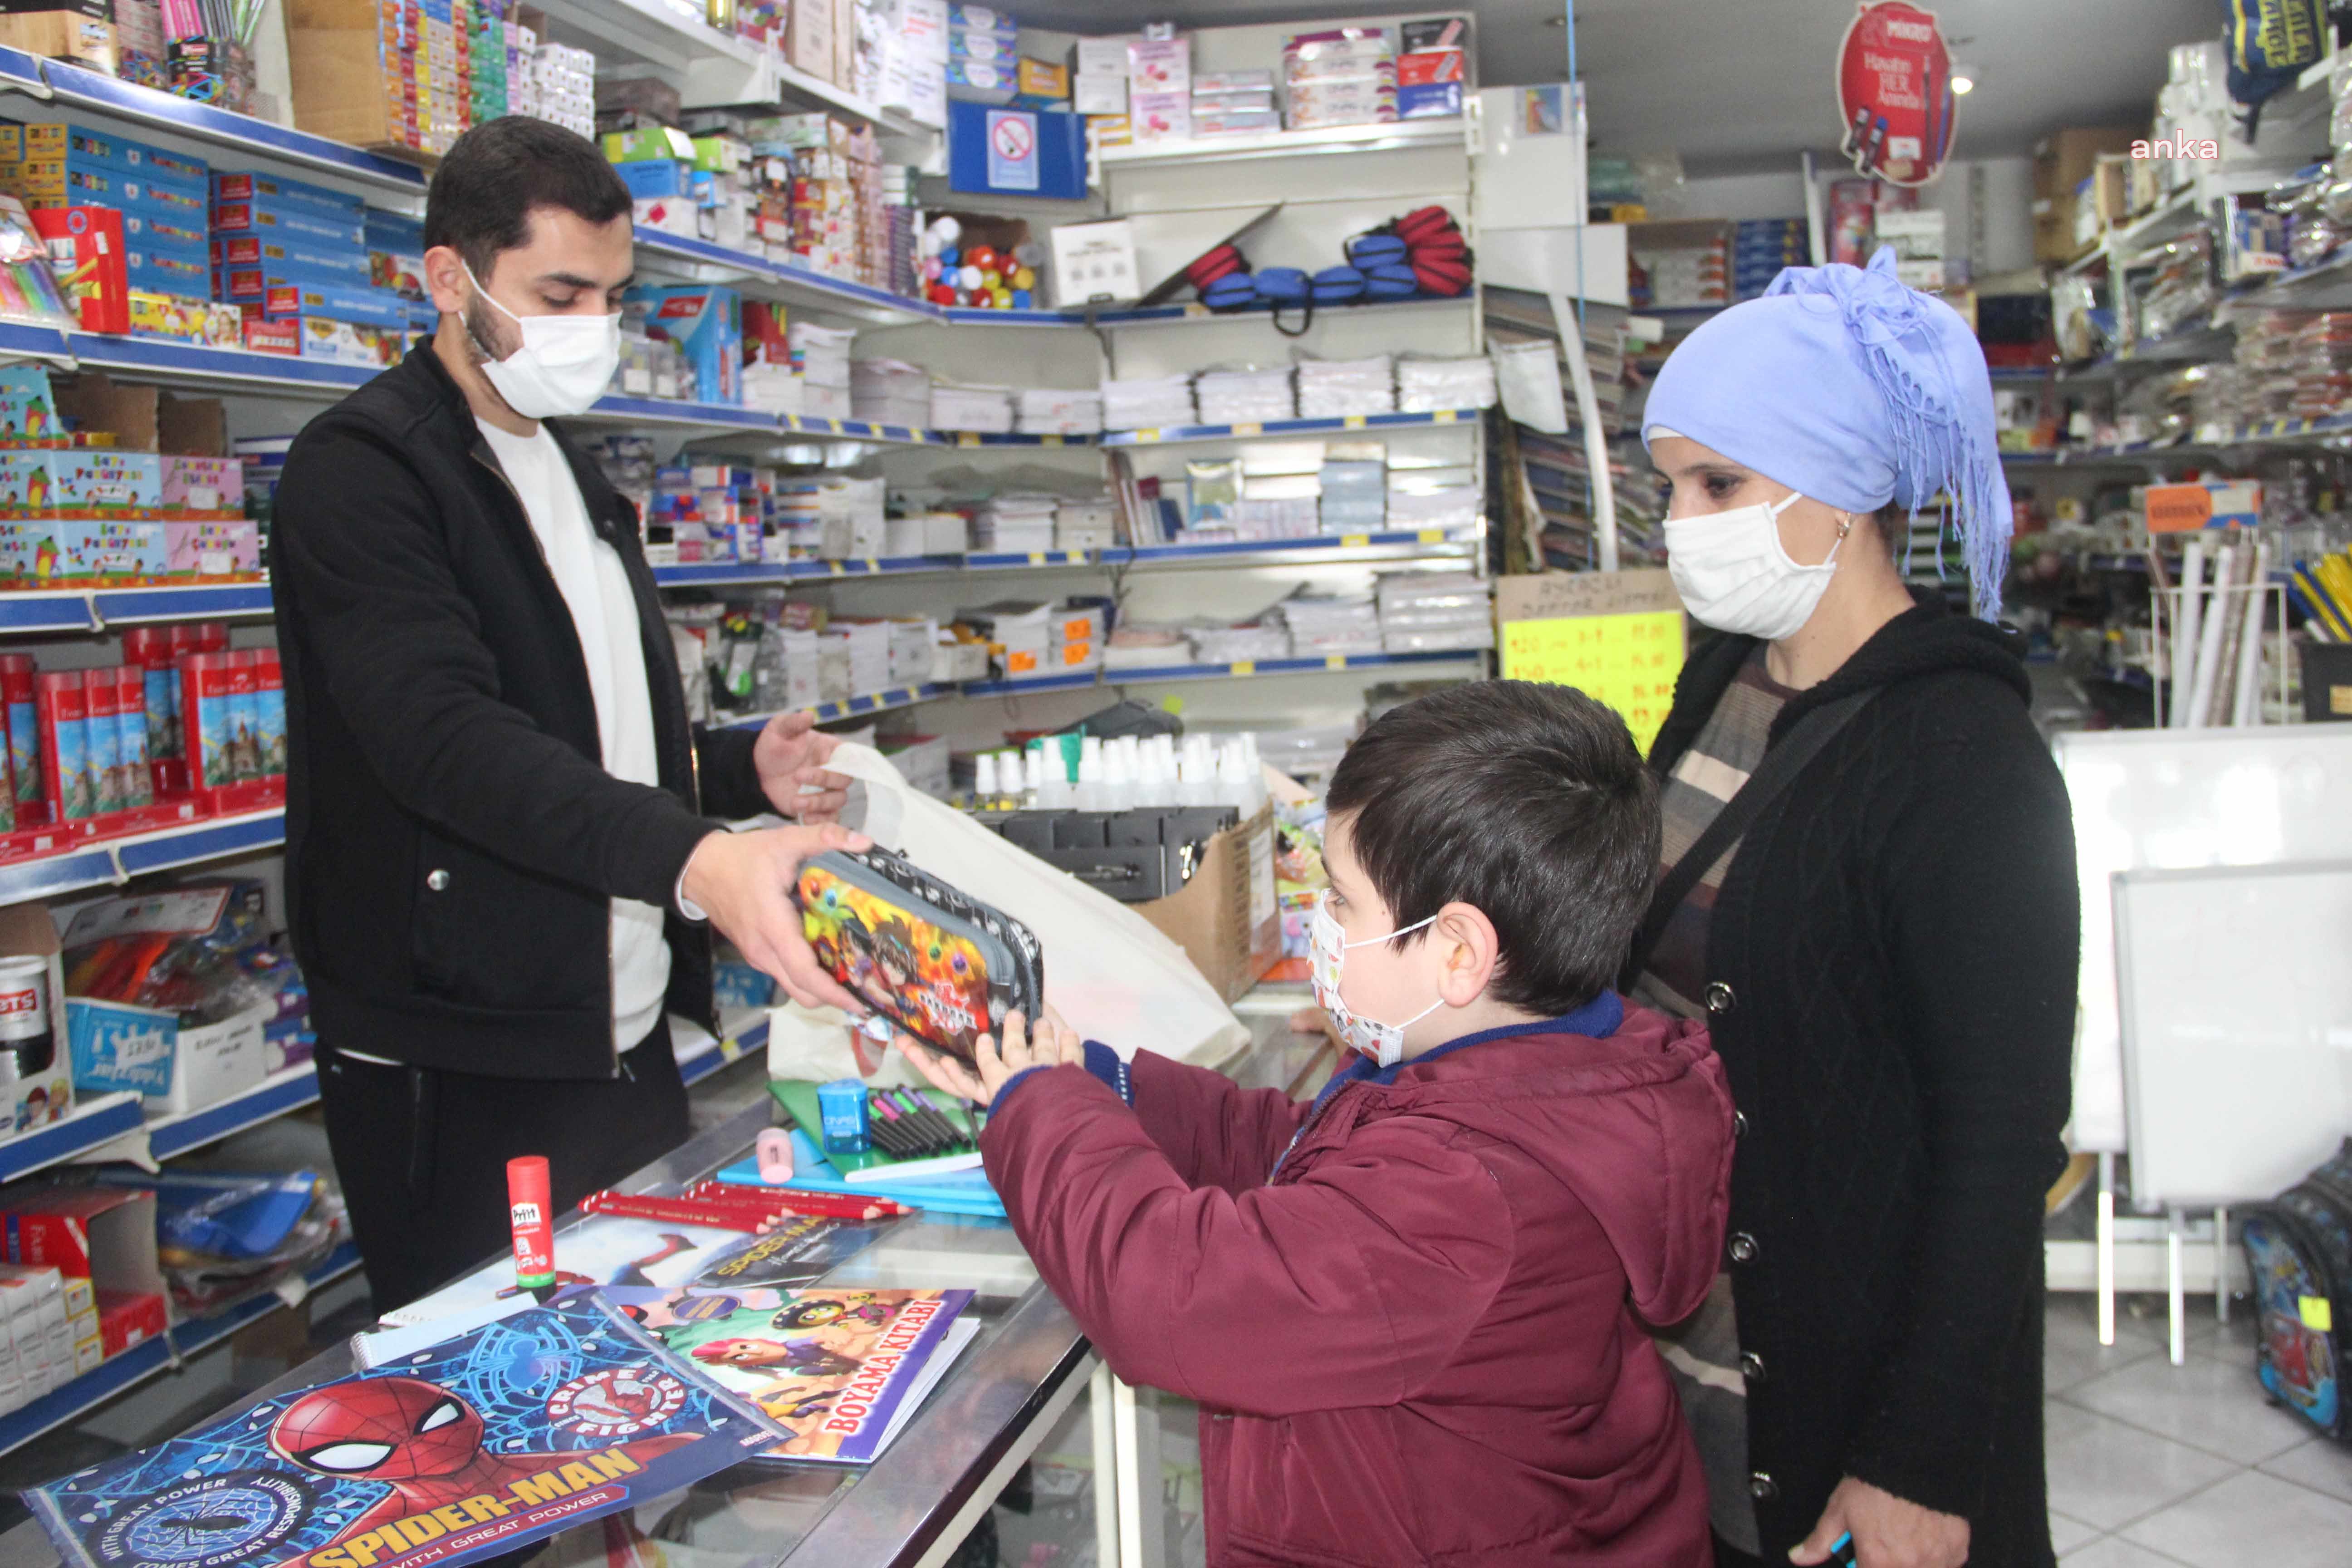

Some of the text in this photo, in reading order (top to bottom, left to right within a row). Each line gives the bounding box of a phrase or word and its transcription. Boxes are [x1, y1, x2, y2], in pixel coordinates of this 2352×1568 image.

[549, 1368, 636, 1415] CRIME
[576, 1377, 684, 1436] FIGHTER
[825, 1300, 942, 1434] BOYAMA KİTABI
[101, 1478, 227, 1561] WITH GREAT POWER
[206, 1538, 267, 1565] GREAT
[250, 1476, 302, 1539] RESPONSIBILITY
[309, 1448, 642, 1568] SPIDER-MAN
[451, 1520, 519, 1549] GREAT
[529, 1492, 608, 1523] POWER
